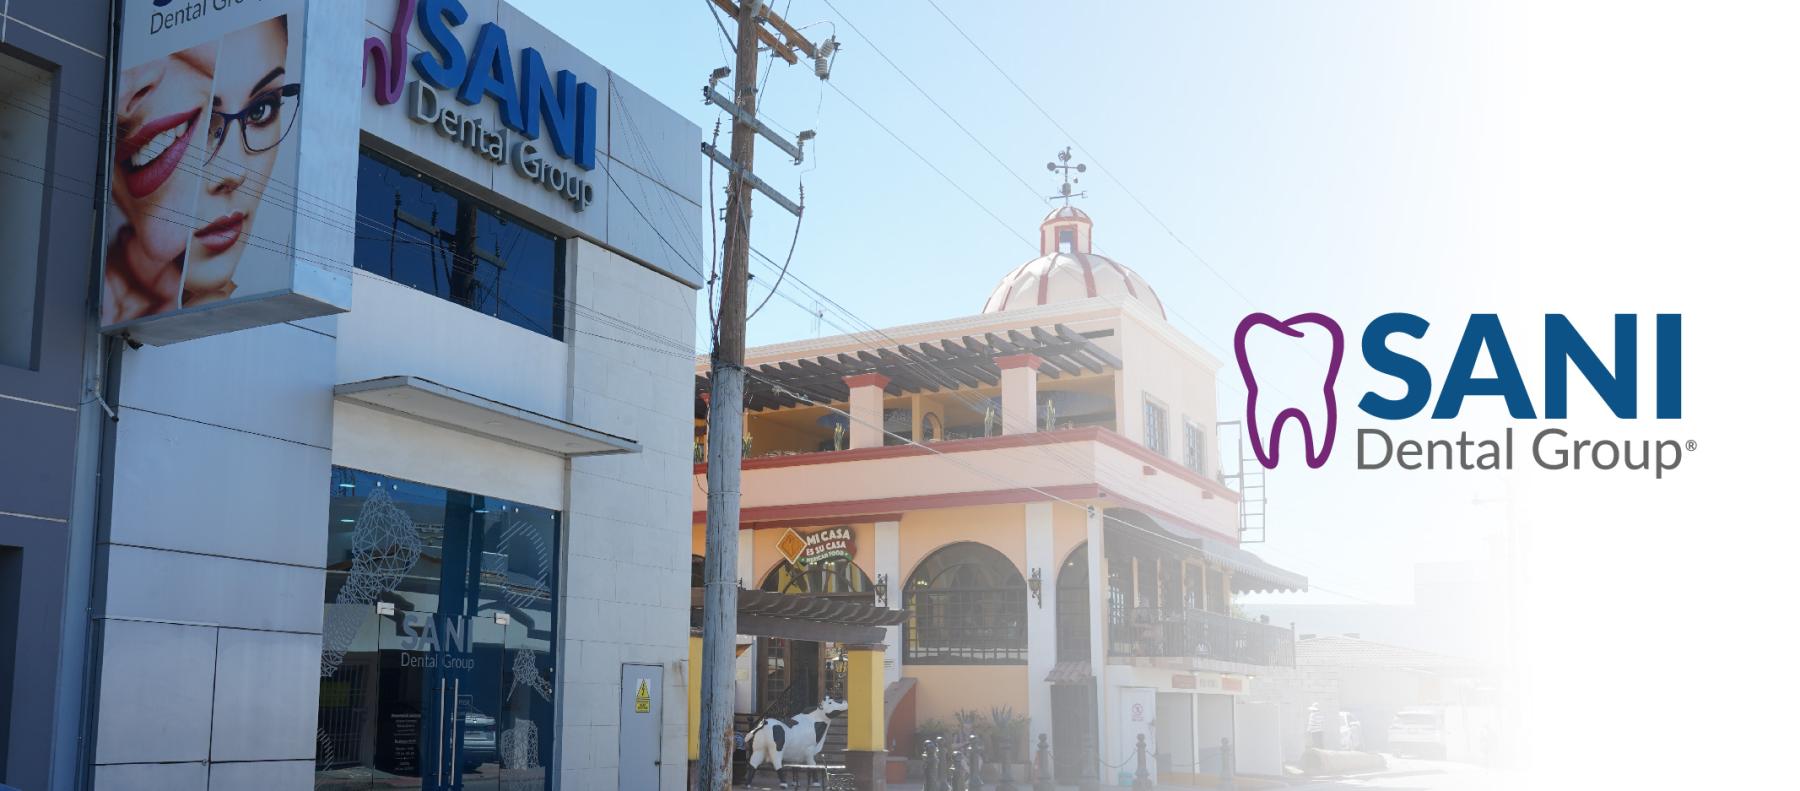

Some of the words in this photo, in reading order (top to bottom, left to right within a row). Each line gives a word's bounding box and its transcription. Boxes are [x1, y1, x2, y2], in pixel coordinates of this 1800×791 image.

[150, 0, 207, 35] Dental
[412, 0, 597, 171] SANI
[409, 79, 511, 166] Dental
[511, 141, 594, 213] Group
[806, 534, 820, 545] MI
[820, 529, 850, 541] CASA
[815, 545, 825, 554] SU
[825, 541, 846, 550] CASA
[401, 615, 473, 653] SANI
[401, 652, 438, 668] Dental
[443, 654, 475, 672] Group
